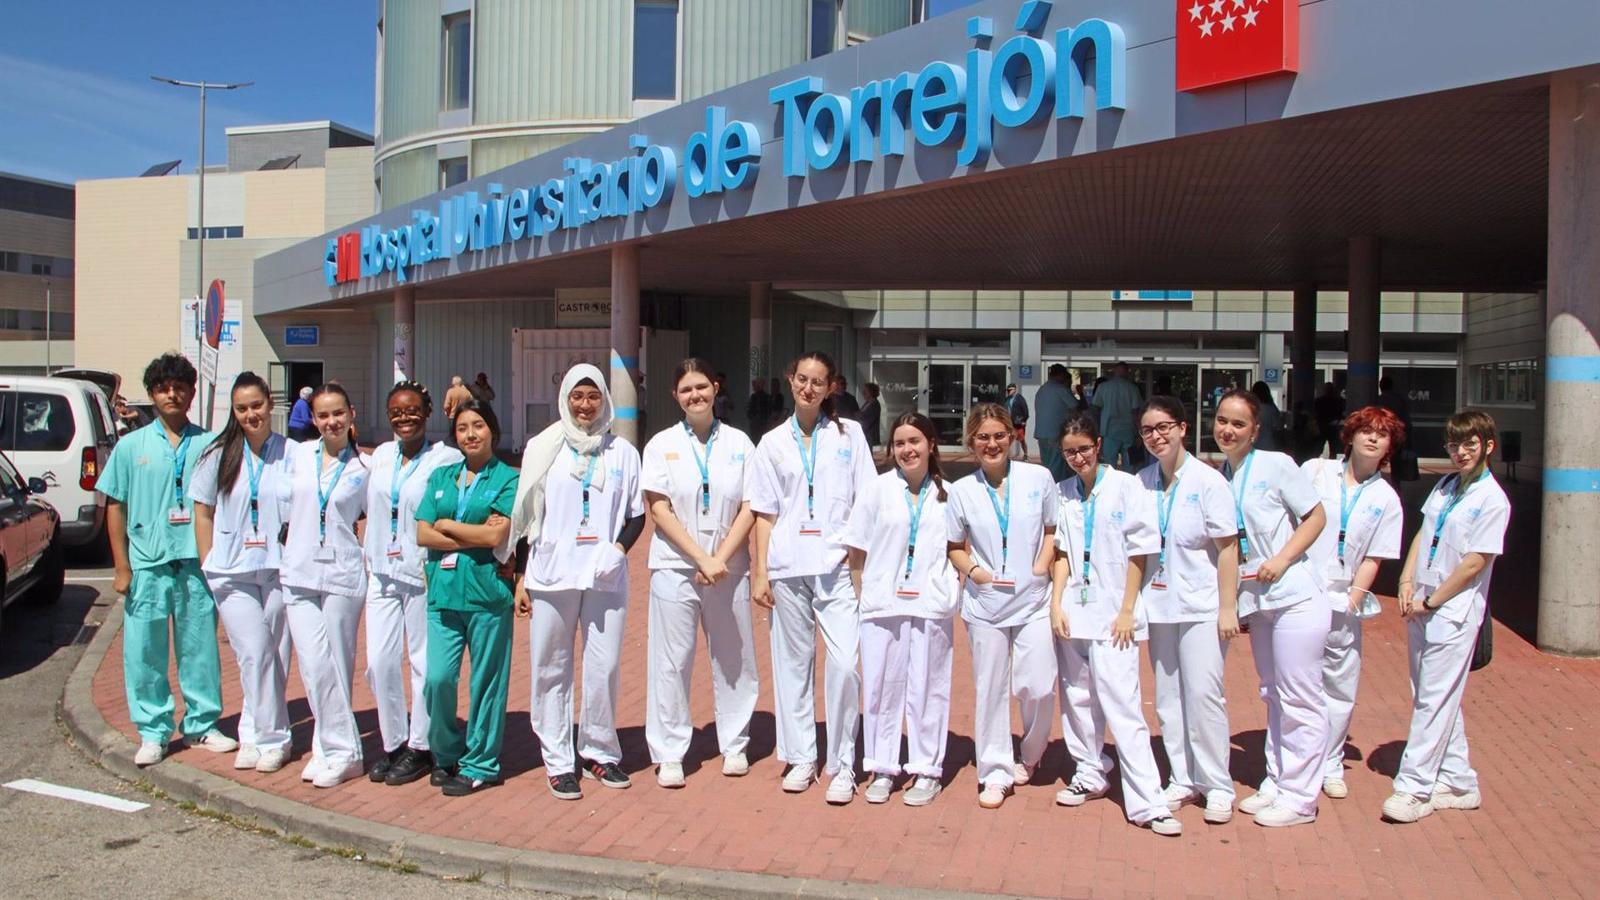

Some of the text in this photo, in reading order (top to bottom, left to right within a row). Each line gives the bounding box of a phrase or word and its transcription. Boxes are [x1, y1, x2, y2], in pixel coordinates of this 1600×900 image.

[361, 200, 451, 283] Hospital
[450, 134, 677, 255] Universitario
[684, 105, 762, 198] de
[769, 0, 1126, 177] Torrejón
